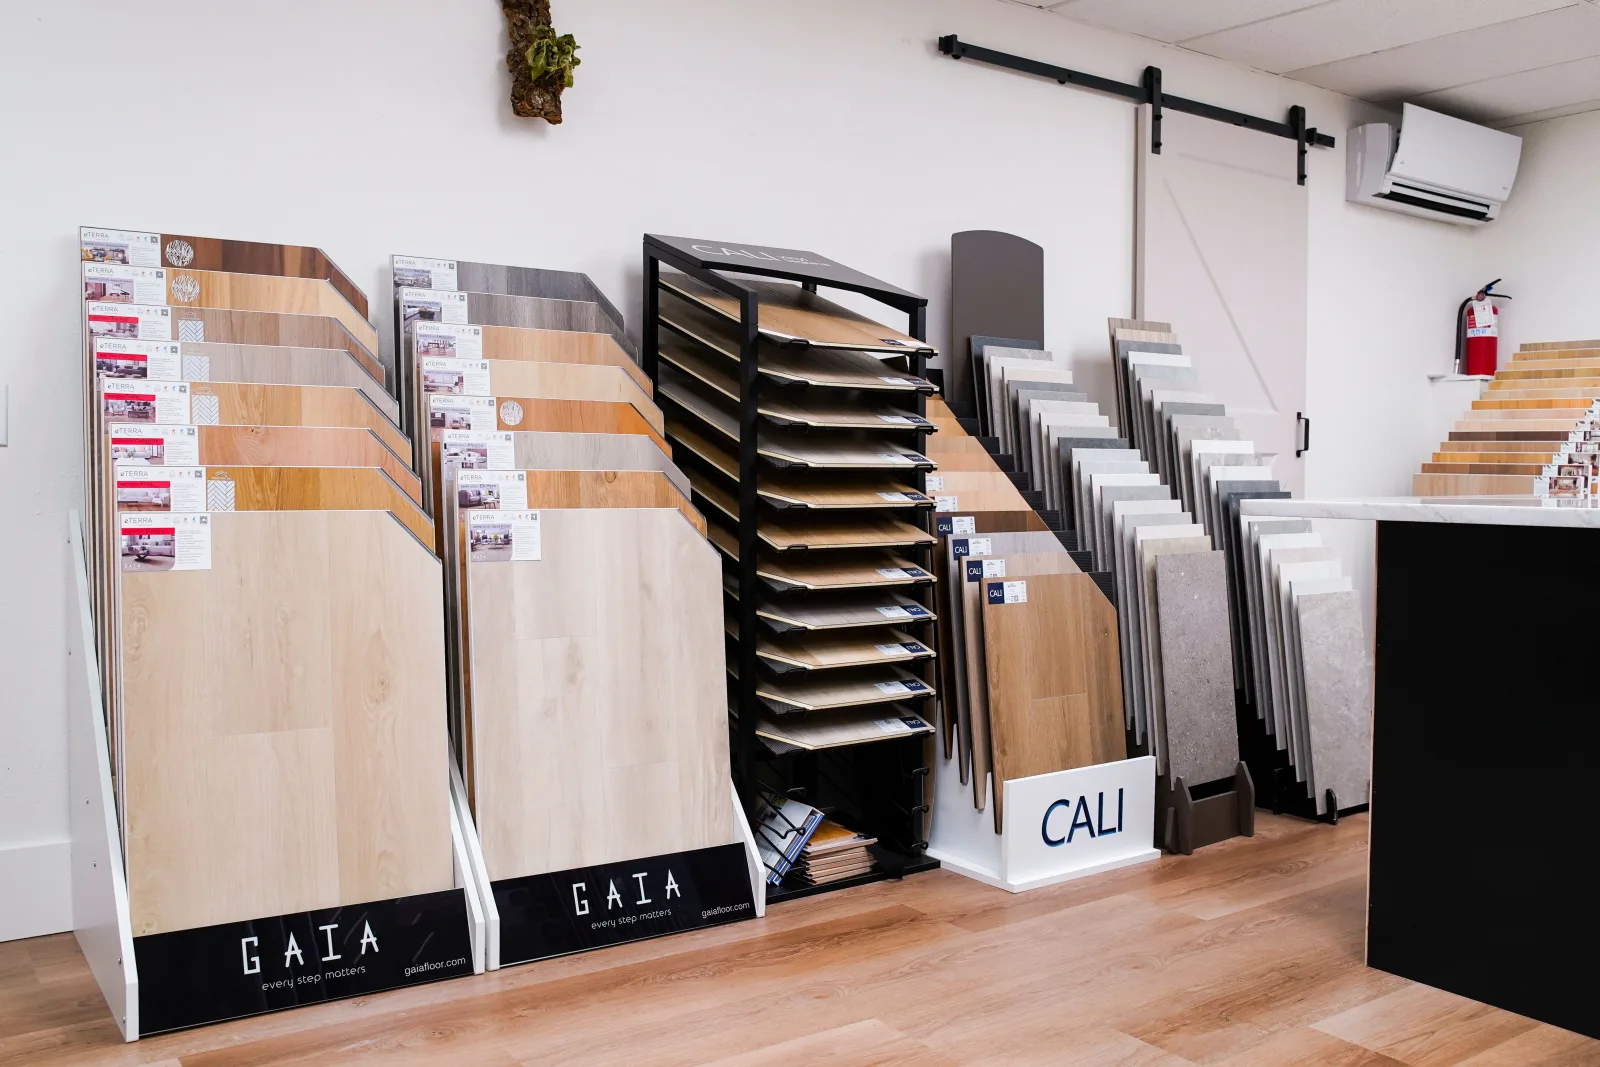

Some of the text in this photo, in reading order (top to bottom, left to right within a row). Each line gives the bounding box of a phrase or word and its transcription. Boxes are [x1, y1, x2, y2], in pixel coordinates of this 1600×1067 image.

[691, 244, 781, 262] CALI
[938, 524, 951, 532] CALI
[954, 546, 968, 554] CALI
[968, 567, 982, 575] CALI
[1041, 788, 1124, 848] CALI
[572, 868, 681, 916] GAIA
[591, 907, 672, 930] every step matters
[701, 901, 750, 919] gaiafloor.com
[241, 919, 379, 976] GAIA
[404, 955, 466, 977] gaiafloor.com
[261, 964, 366, 992] every step matters
